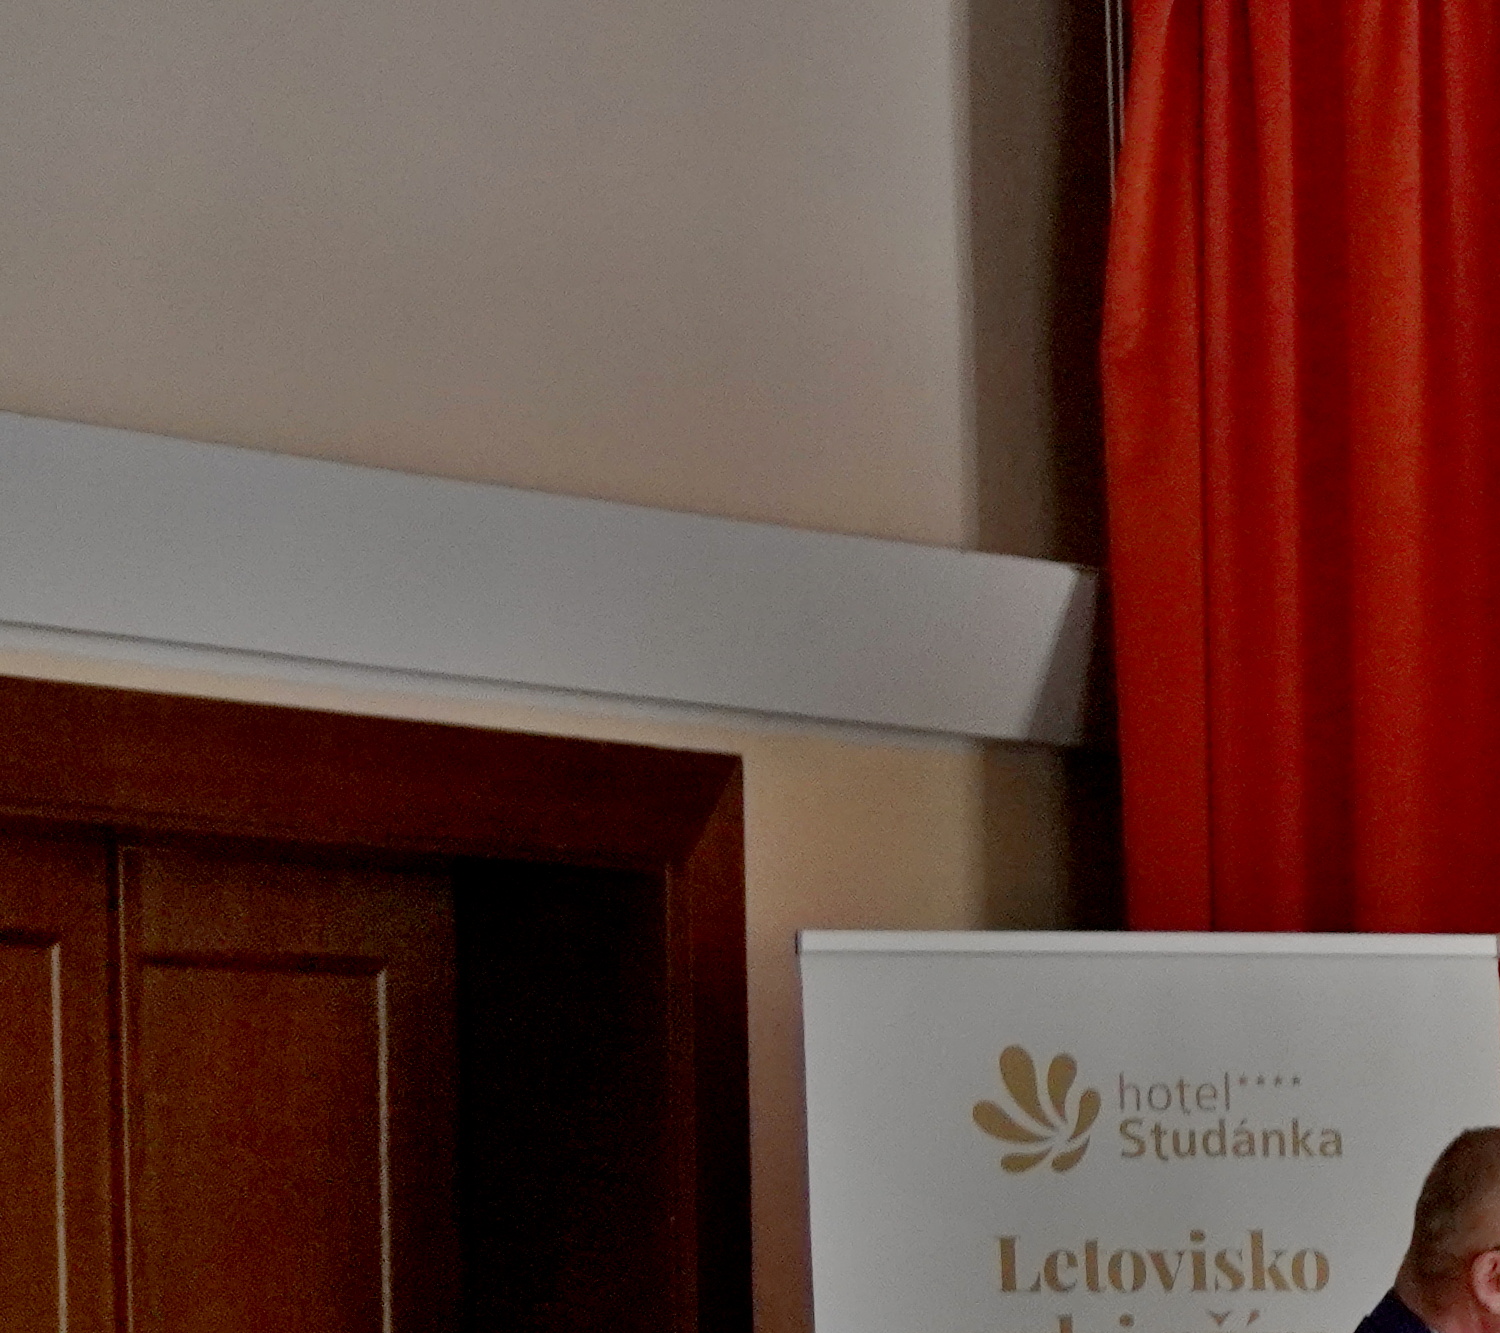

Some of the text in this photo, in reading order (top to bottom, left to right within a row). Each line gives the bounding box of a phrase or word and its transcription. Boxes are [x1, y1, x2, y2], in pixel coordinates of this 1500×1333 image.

[1118, 1071, 1233, 1116] hotel
[1117, 1116, 1344, 1161] Studánka
[996, 1228, 1331, 1294] Letovisko
